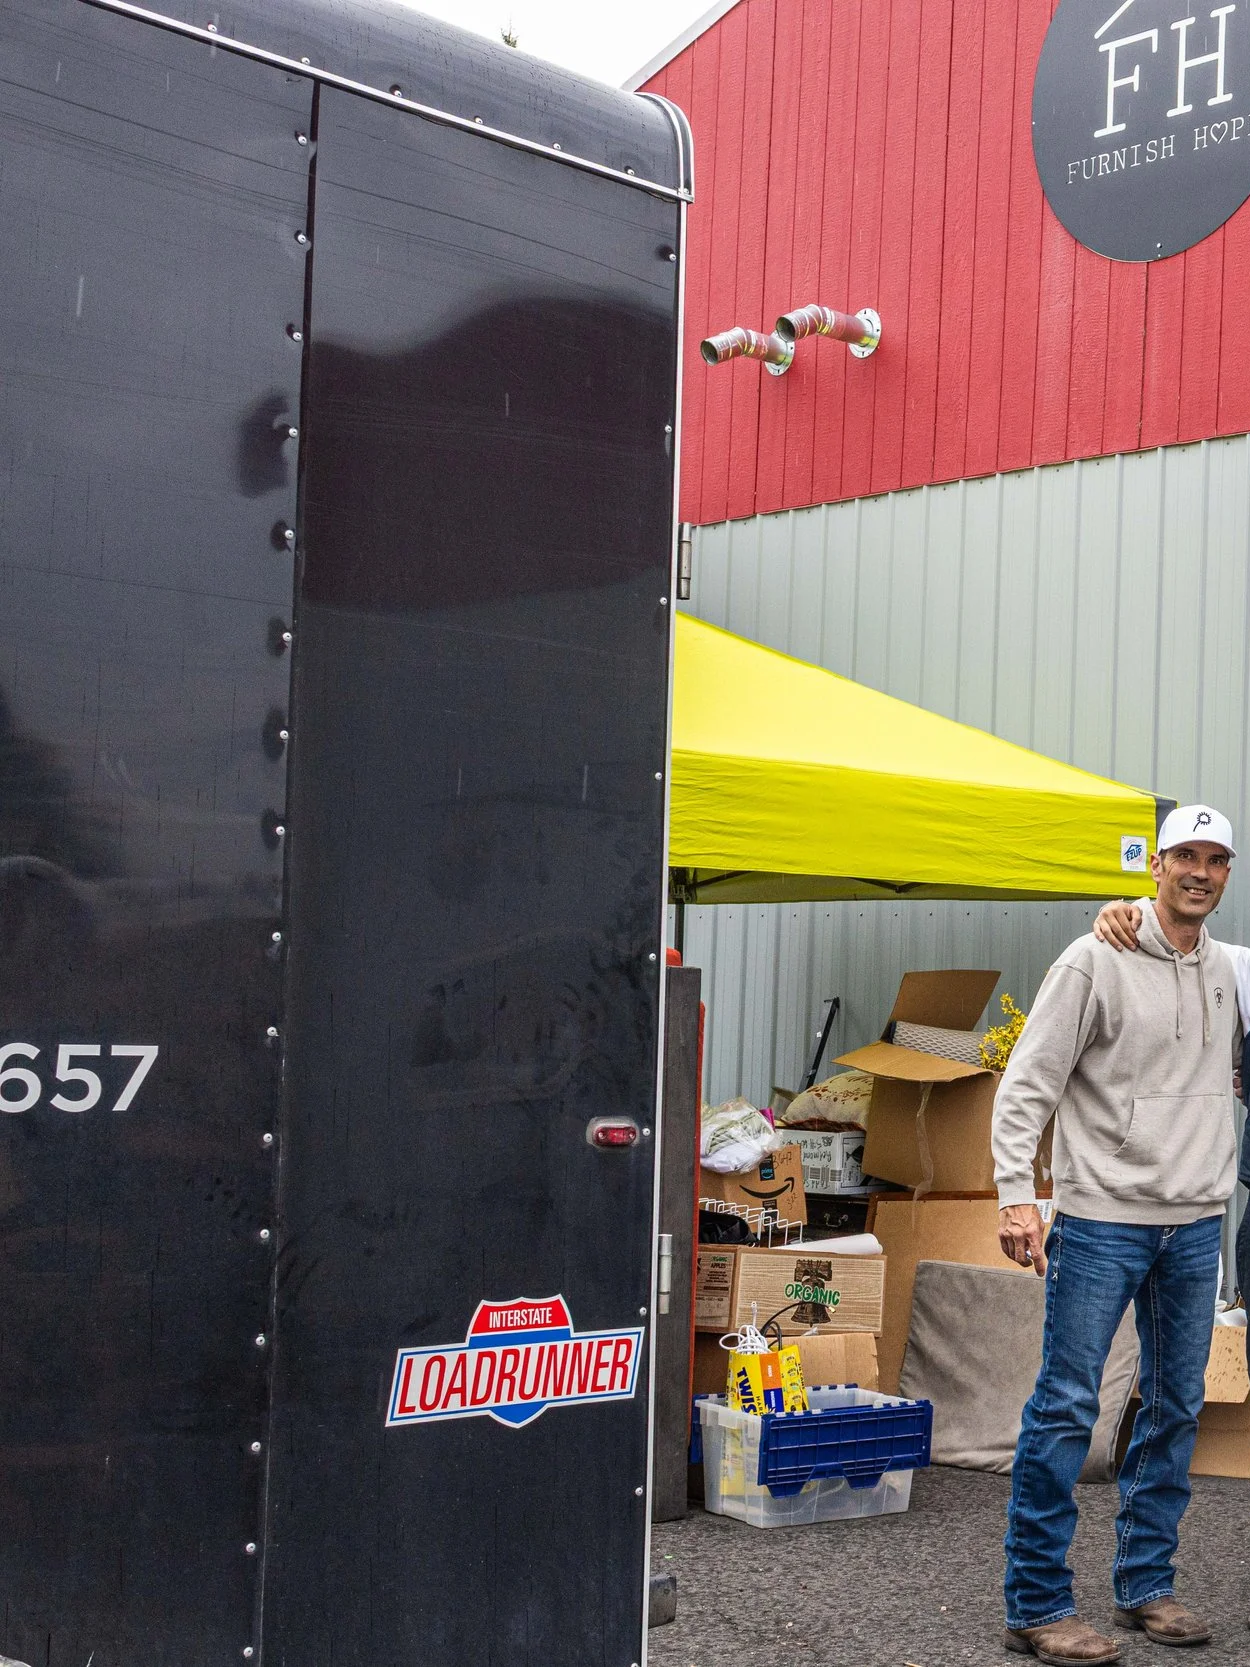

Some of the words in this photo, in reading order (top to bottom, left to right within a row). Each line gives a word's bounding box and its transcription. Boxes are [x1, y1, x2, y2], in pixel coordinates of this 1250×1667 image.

[1094, 4, 1236, 138] FH
[1066, 134, 1176, 185] FURNISH
[0, 1042, 159, 1114] 657
[489, 1307, 553, 1329] INTERSTATE
[784, 1282, 841, 1307] ORGANIC
[398, 1338, 633, 1414] LOADRUNNER
[737, 1366, 758, 1416] TWIS
